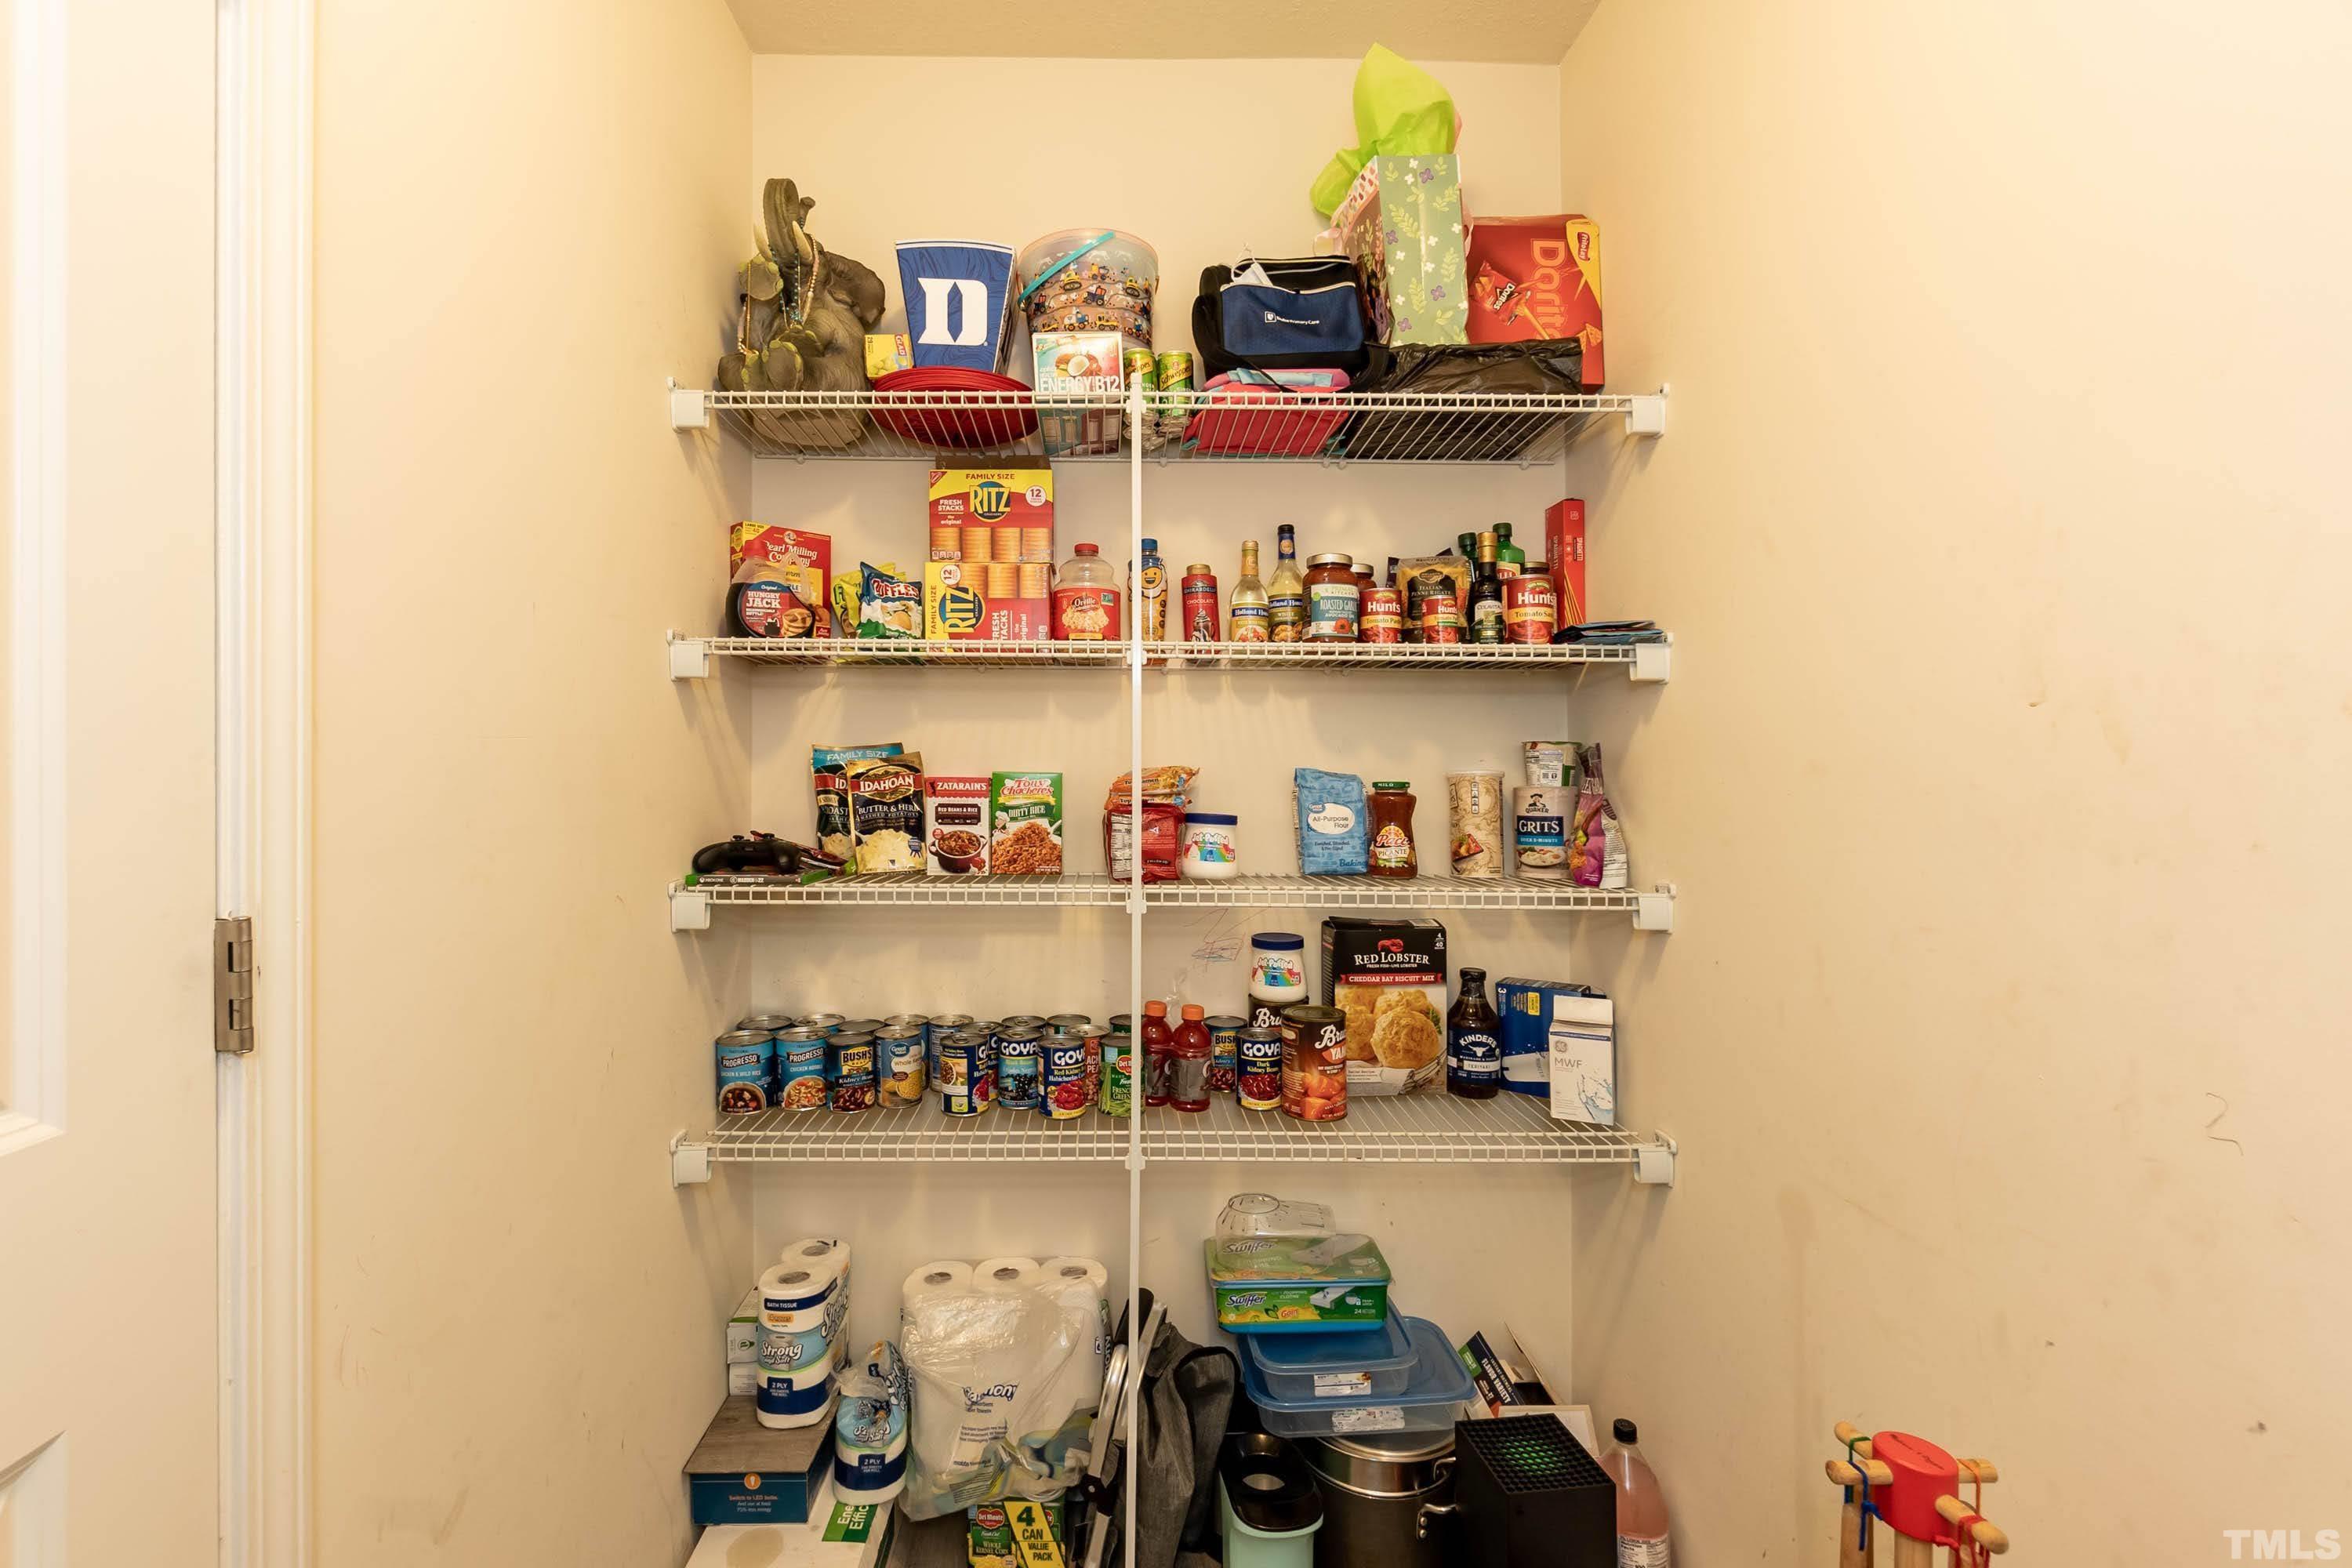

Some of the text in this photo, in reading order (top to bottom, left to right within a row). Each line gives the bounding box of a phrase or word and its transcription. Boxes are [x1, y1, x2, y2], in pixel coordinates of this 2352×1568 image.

[1532, 238, 1568, 339] Dorit
[1493, 282, 1516, 311] Doritos
[917, 278, 988, 345] D
[895, 336, 906, 355] GLAD
[1040, 376, 1120, 392] ENERGY B12
[968, 485, 1011, 514] RITZ
[1029, 488, 1042, 498] 12
[786, 544, 818, 561] Milling
[943, 569, 952, 580] 12
[746, 597, 782, 608] JACK
[1074, 597, 1096, 606] Orville
[1319, 599, 1344, 611] ROASTED
[943, 586, 977, 633] RITZ
[827, 751, 863, 761] FAMILY
[859, 774, 915, 792] IDAHOAN
[858, 804, 889, 815] BUTTER
[1008, 804, 1046, 818] DIRTY RICE
[1519, 820, 1560, 834] GRITS
[1376, 834, 1409, 848] Pace
[1354, 952, 1430, 965] RED LOBSTER
[789, 1048, 824, 1062] PROGRESSO
[1000, 1041, 1038, 1055] GOYA
[1243, 1042, 1281, 1057] GOYA
[722, 1054, 757, 1067] PROGRESSO
[1054, 1048, 1085, 1065] GOY
[1555, 1057, 1583, 1068] MWF
[1247, 1065, 1266, 1073] Kidney
[1112, 1086, 1131, 1094] FRENC
[1222, 1240, 1276, 1254] Swiffer
[1226, 1292, 1267, 1308] Swiffer
[1281, 1309, 1298, 1318] Gain
[760, 1341, 804, 1360] Strong
[1481, 1358, 1512, 1403] FLAVOR VARIETY
[1017, 1506, 1036, 1526] 4
[1022, 1529, 1044, 1540] CAN
[1033, 1552, 1053, 1561] PACK
